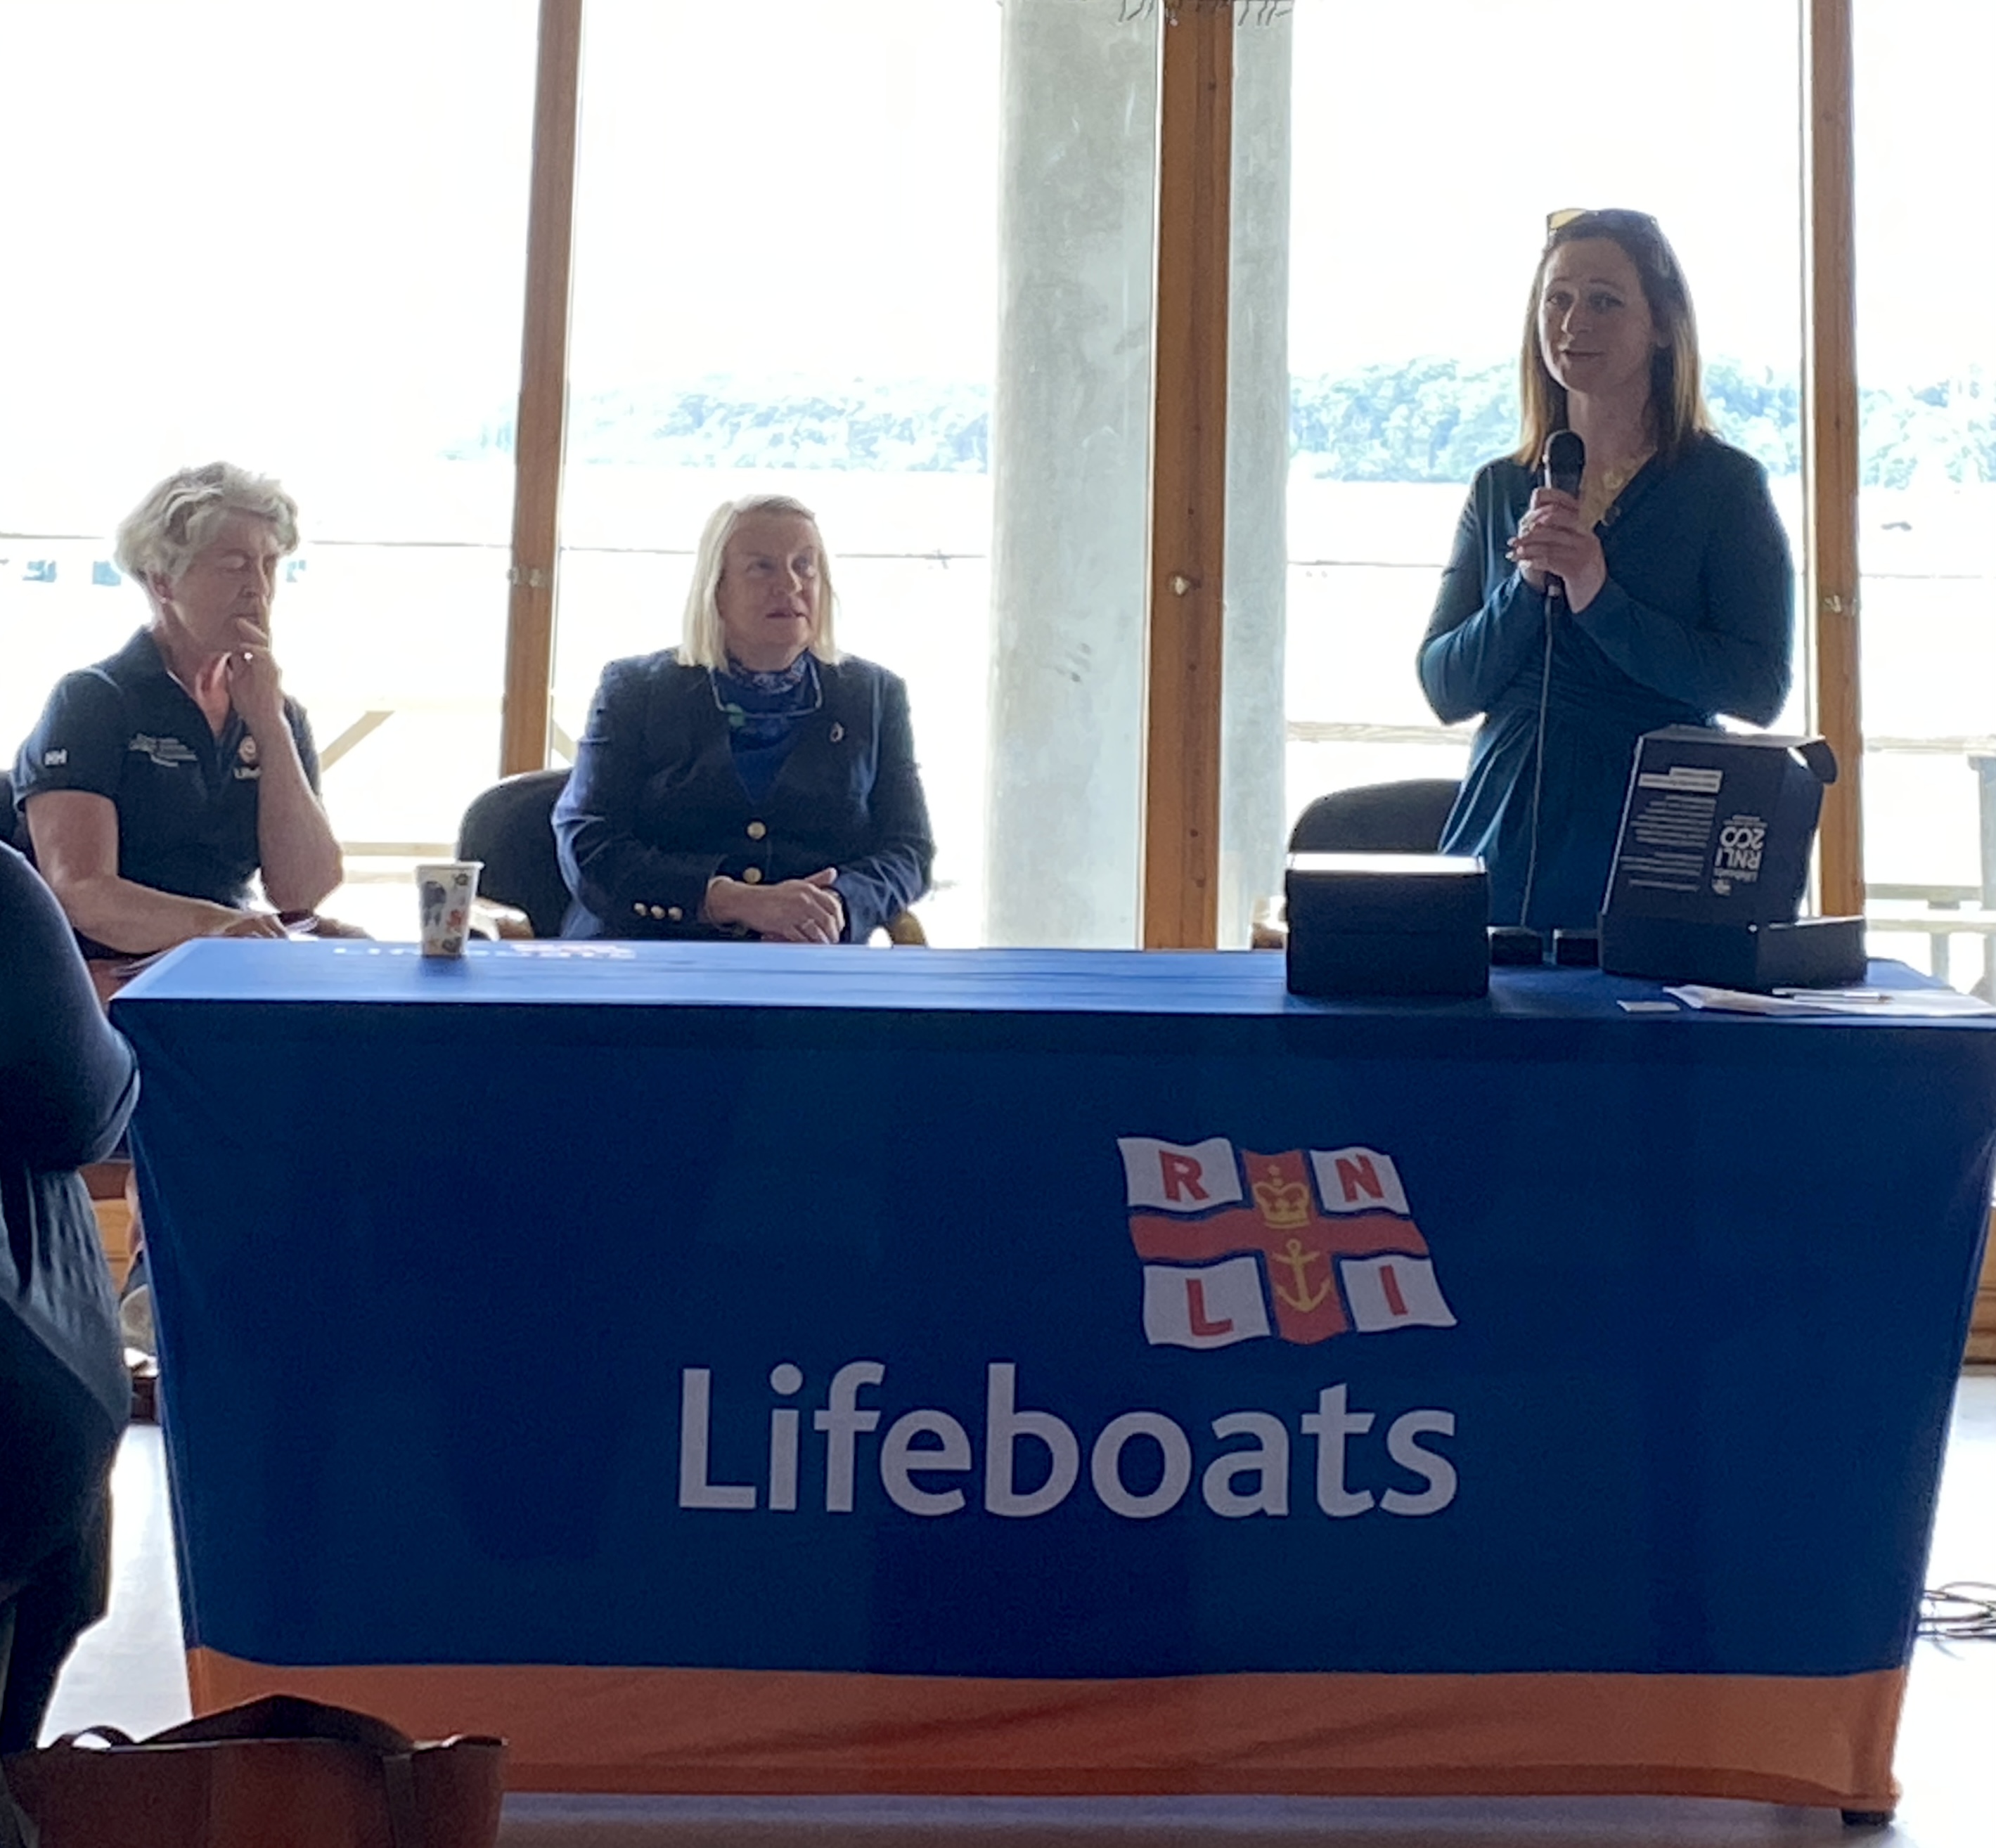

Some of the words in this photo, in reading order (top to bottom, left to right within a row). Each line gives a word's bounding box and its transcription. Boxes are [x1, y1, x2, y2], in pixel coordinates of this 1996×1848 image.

[1715, 847, 1761, 870] RNLI
[1159, 1149, 1210, 1203] R
[1335, 1153, 1385, 1203] N
[1185, 1278, 1234, 1337] L
[1379, 1265, 1409, 1316] I
[678, 1359, 1459, 1518] Lifeboats
